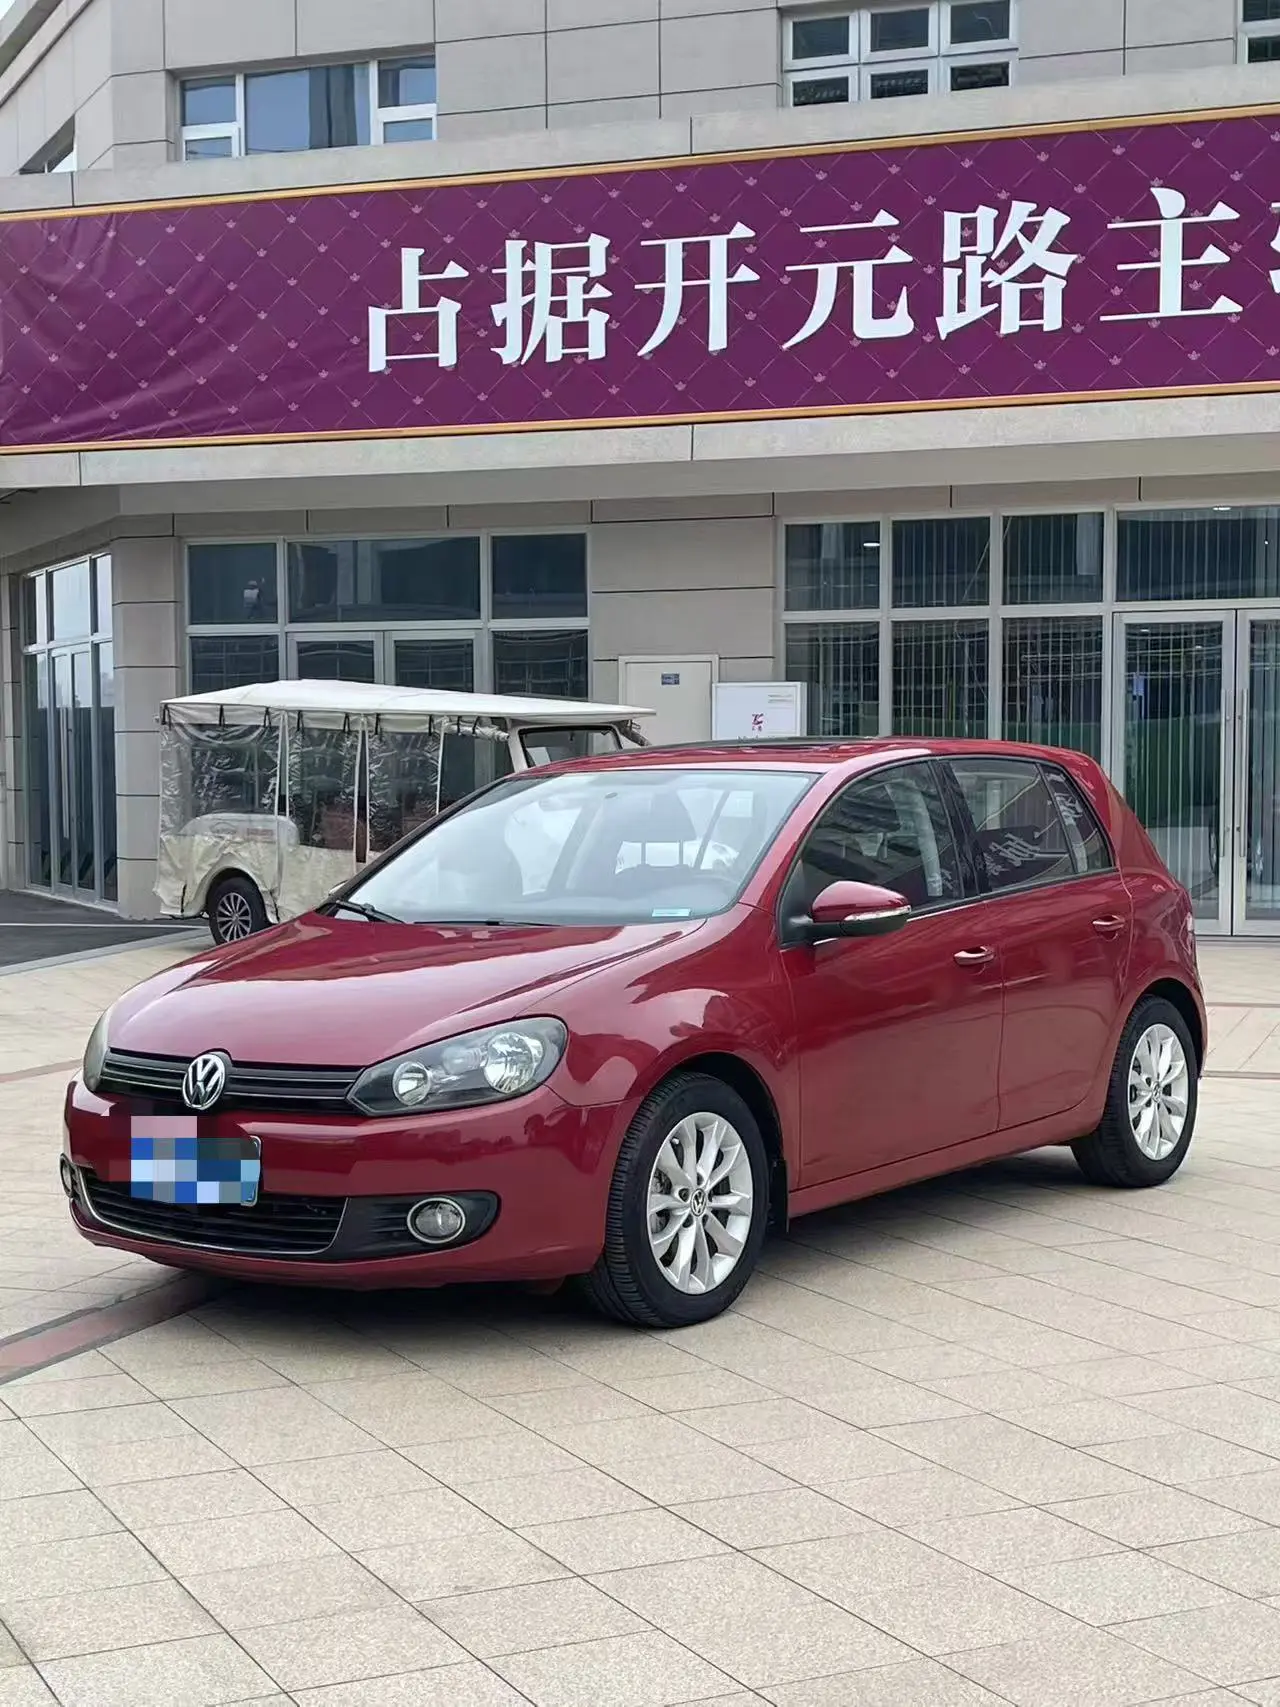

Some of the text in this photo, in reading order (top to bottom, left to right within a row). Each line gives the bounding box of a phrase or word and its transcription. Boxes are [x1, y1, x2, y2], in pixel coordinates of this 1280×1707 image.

[367, 187, 1280, 373] 占据开元路主
[183, 1053, 225, 1109] VW
